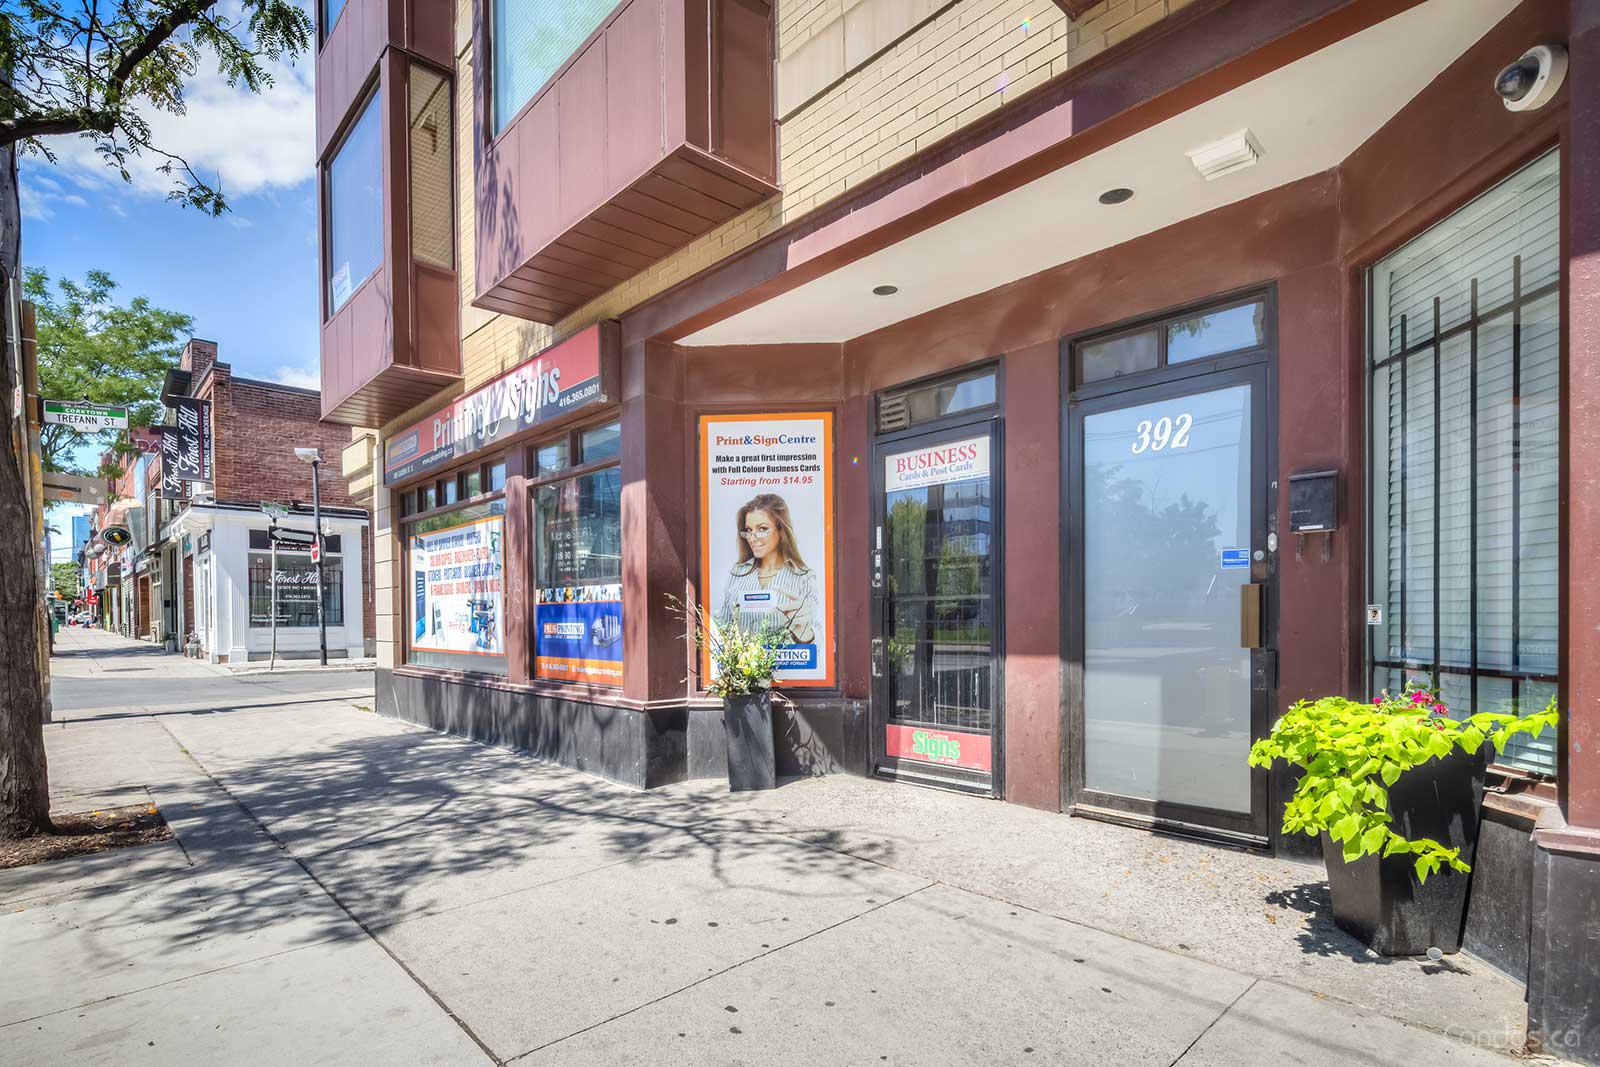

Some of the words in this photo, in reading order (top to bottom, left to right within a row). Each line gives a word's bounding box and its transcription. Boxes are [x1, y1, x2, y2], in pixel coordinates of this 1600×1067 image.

[64, 408, 108, 416] CORKTOWN
[433, 403, 487, 452] Printing
[509, 367, 561, 424] Signs
[56, 414, 98, 425] TREFANN
[104, 418, 115, 426] ST
[178, 404, 199, 435] Hill
[202, 405, 210, 435] BROKERAGE
[716, 434, 816, 447] Print&SignCentre
[1132, 413, 1193, 454] 392
[178, 434, 200, 474] Forest
[715, 455, 734, 463] Make
[741, 454, 760, 463] great
[761, 454, 776, 462] first
[777, 453, 817, 462] impression
[896, 443, 977, 473] BUSINESS
[712, 465, 727, 474] with
[728, 465, 741, 473] Full
[742, 465, 765, 473] Colour
[767, 465, 799, 473] Business
[800, 464, 821, 472] Cards
[899, 471, 920, 481] Cards
[922, 470, 929, 478] &
[930, 466, 948, 476] Post
[949, 461, 973, 473] Cards
[720, 476, 757, 487] Starting
[759, 476, 780, 485] from
[783, 475, 813, 485] $14.95
[268, 570, 300, 583] Forest
[301, 571, 319, 583] Hi
[557, 624, 583, 634] PRINTING
[912, 730, 961, 761] Signs
